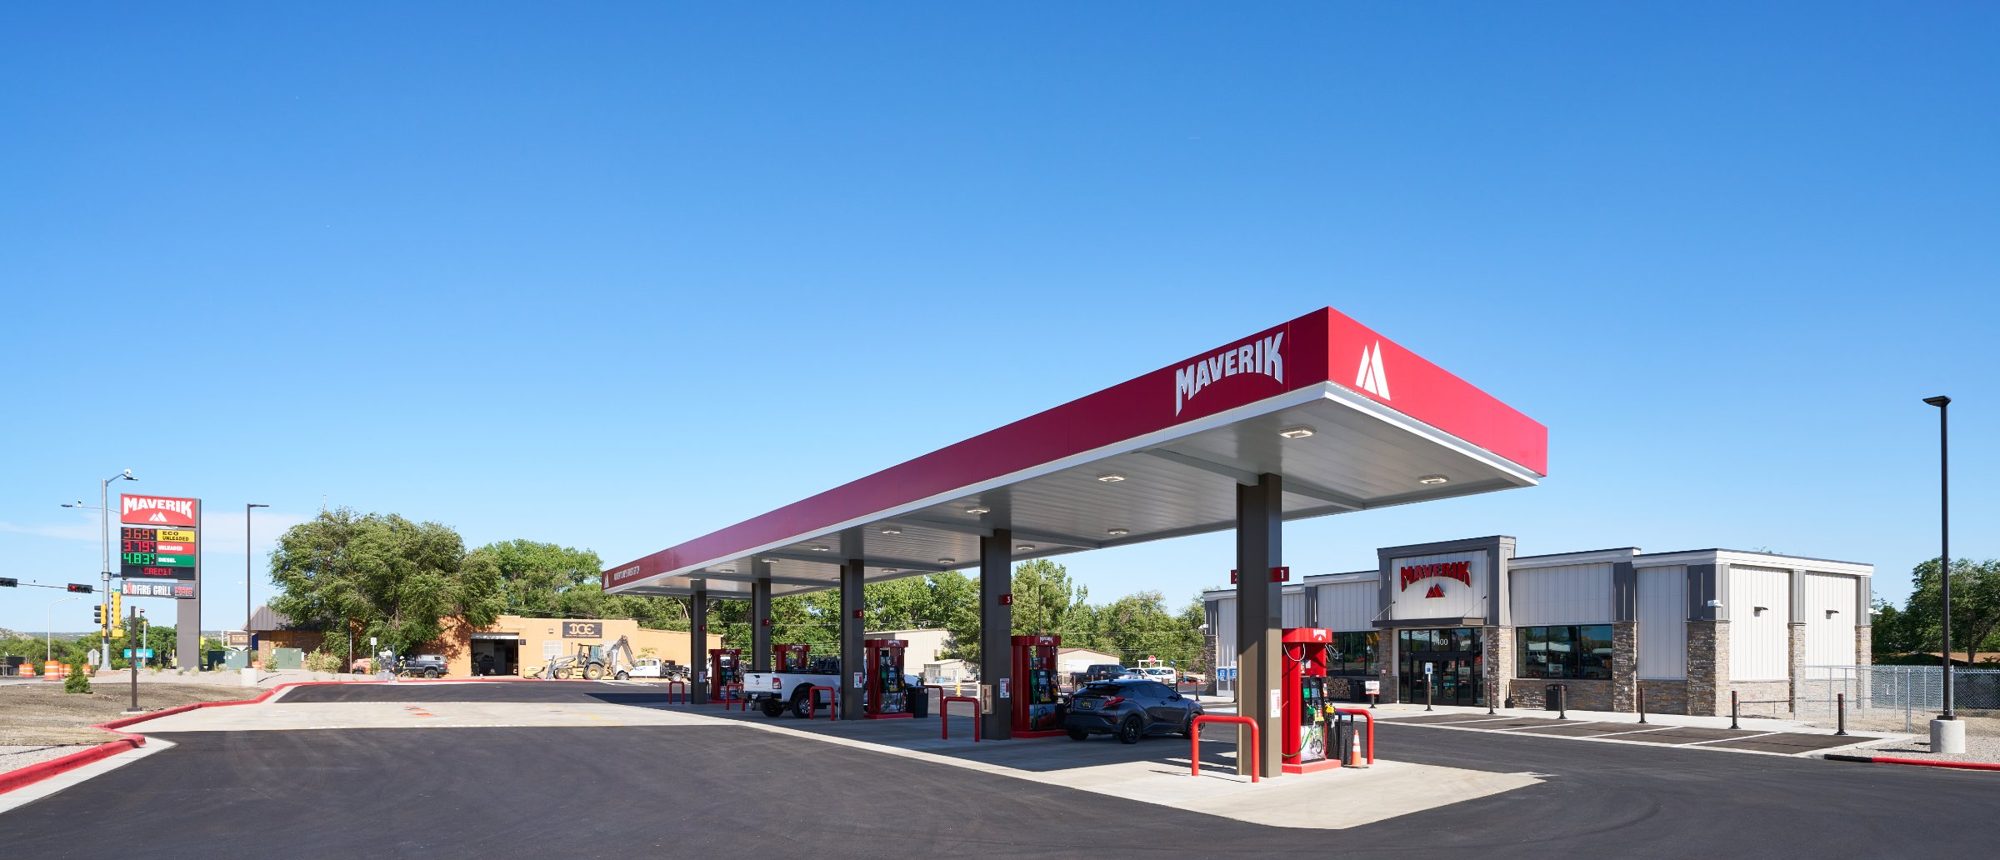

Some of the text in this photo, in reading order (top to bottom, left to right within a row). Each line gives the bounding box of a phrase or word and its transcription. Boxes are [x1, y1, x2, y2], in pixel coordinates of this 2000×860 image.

[1175, 331, 1284, 417] MAVERIK
[123, 497, 193, 520] MAVERIK
[144, 567, 173, 575] CREDIT
[1280, 569, 1285, 579] 1
[1401, 561, 1472, 592] MAVERIK
[153, 585, 171, 596] GRILL
